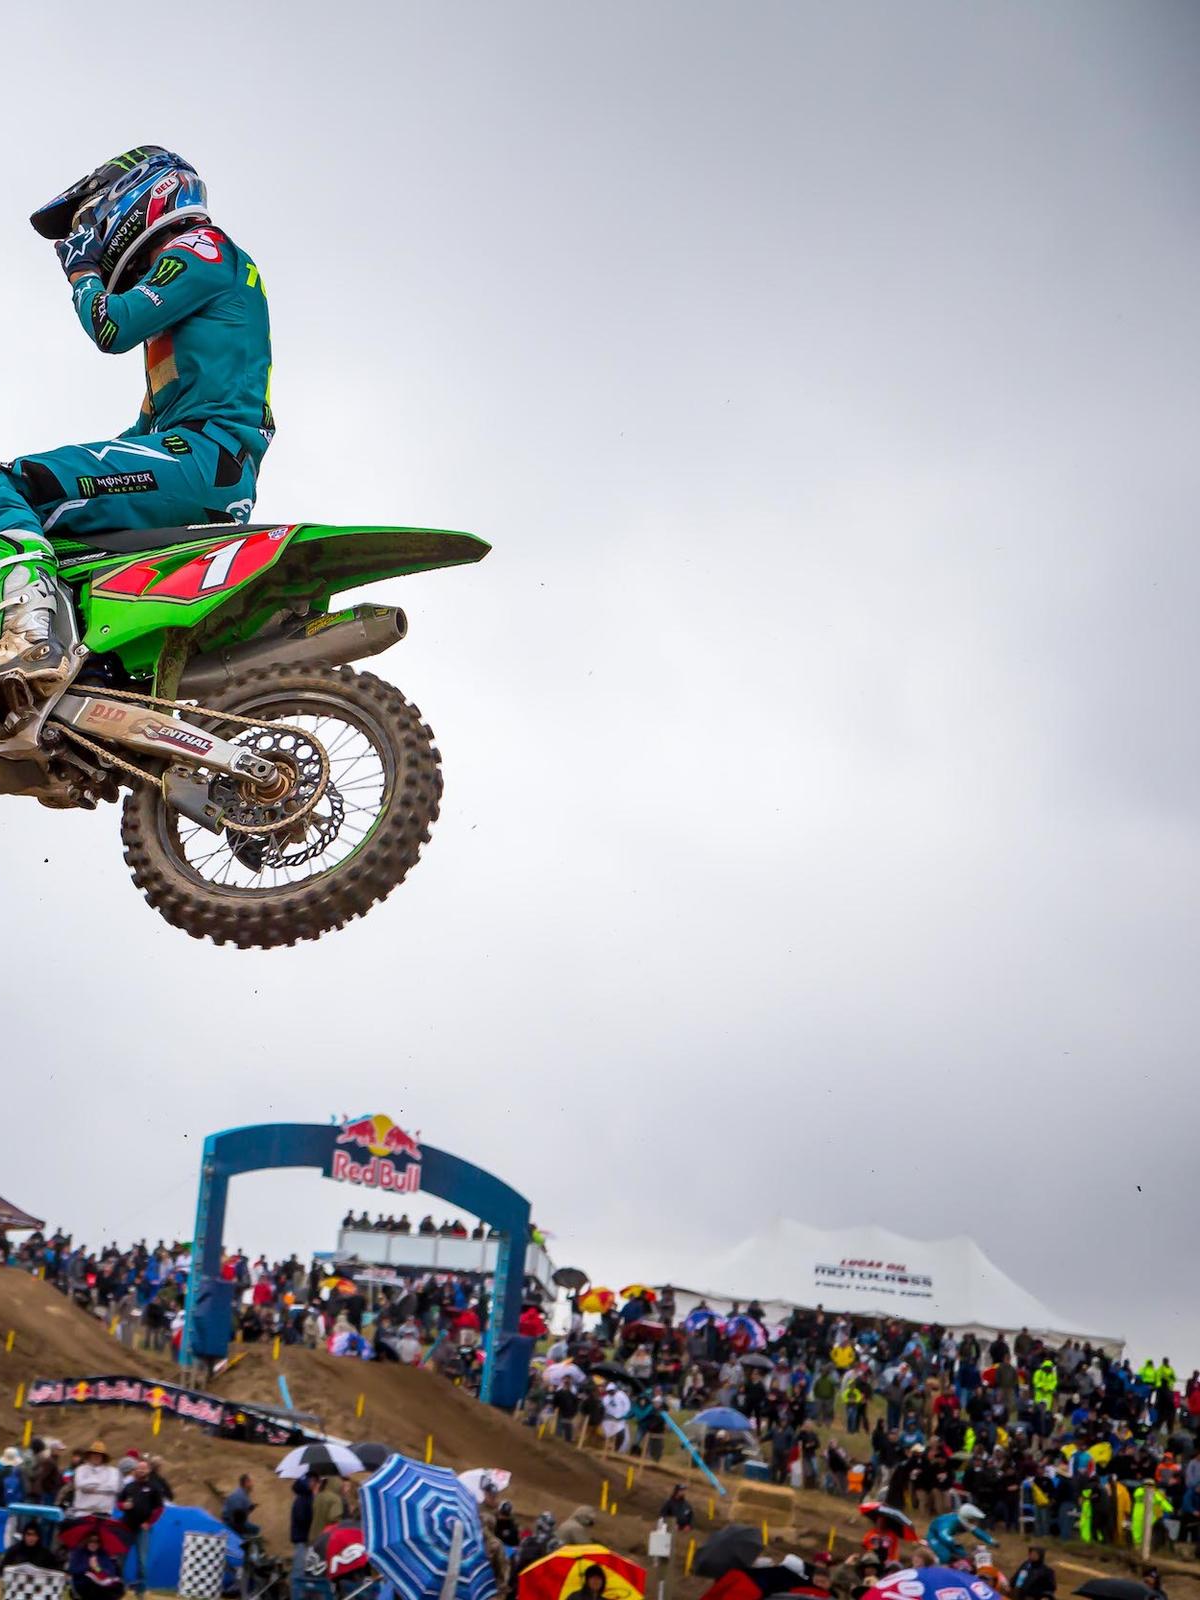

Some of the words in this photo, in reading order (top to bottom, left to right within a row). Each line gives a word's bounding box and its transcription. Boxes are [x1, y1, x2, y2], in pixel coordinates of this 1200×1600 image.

[155, 179, 176, 195] BELL
[107, 209, 144, 256] MONSTER
[96, 473, 153, 488] MONSTER
[108, 485, 148, 493] ENERGY
[202, 538, 247, 590] 1
[332, 1149, 379, 1188] Red
[378, 1158, 421, 1194] Bull
[815, 1265, 933, 1288] MOTOCROSS
